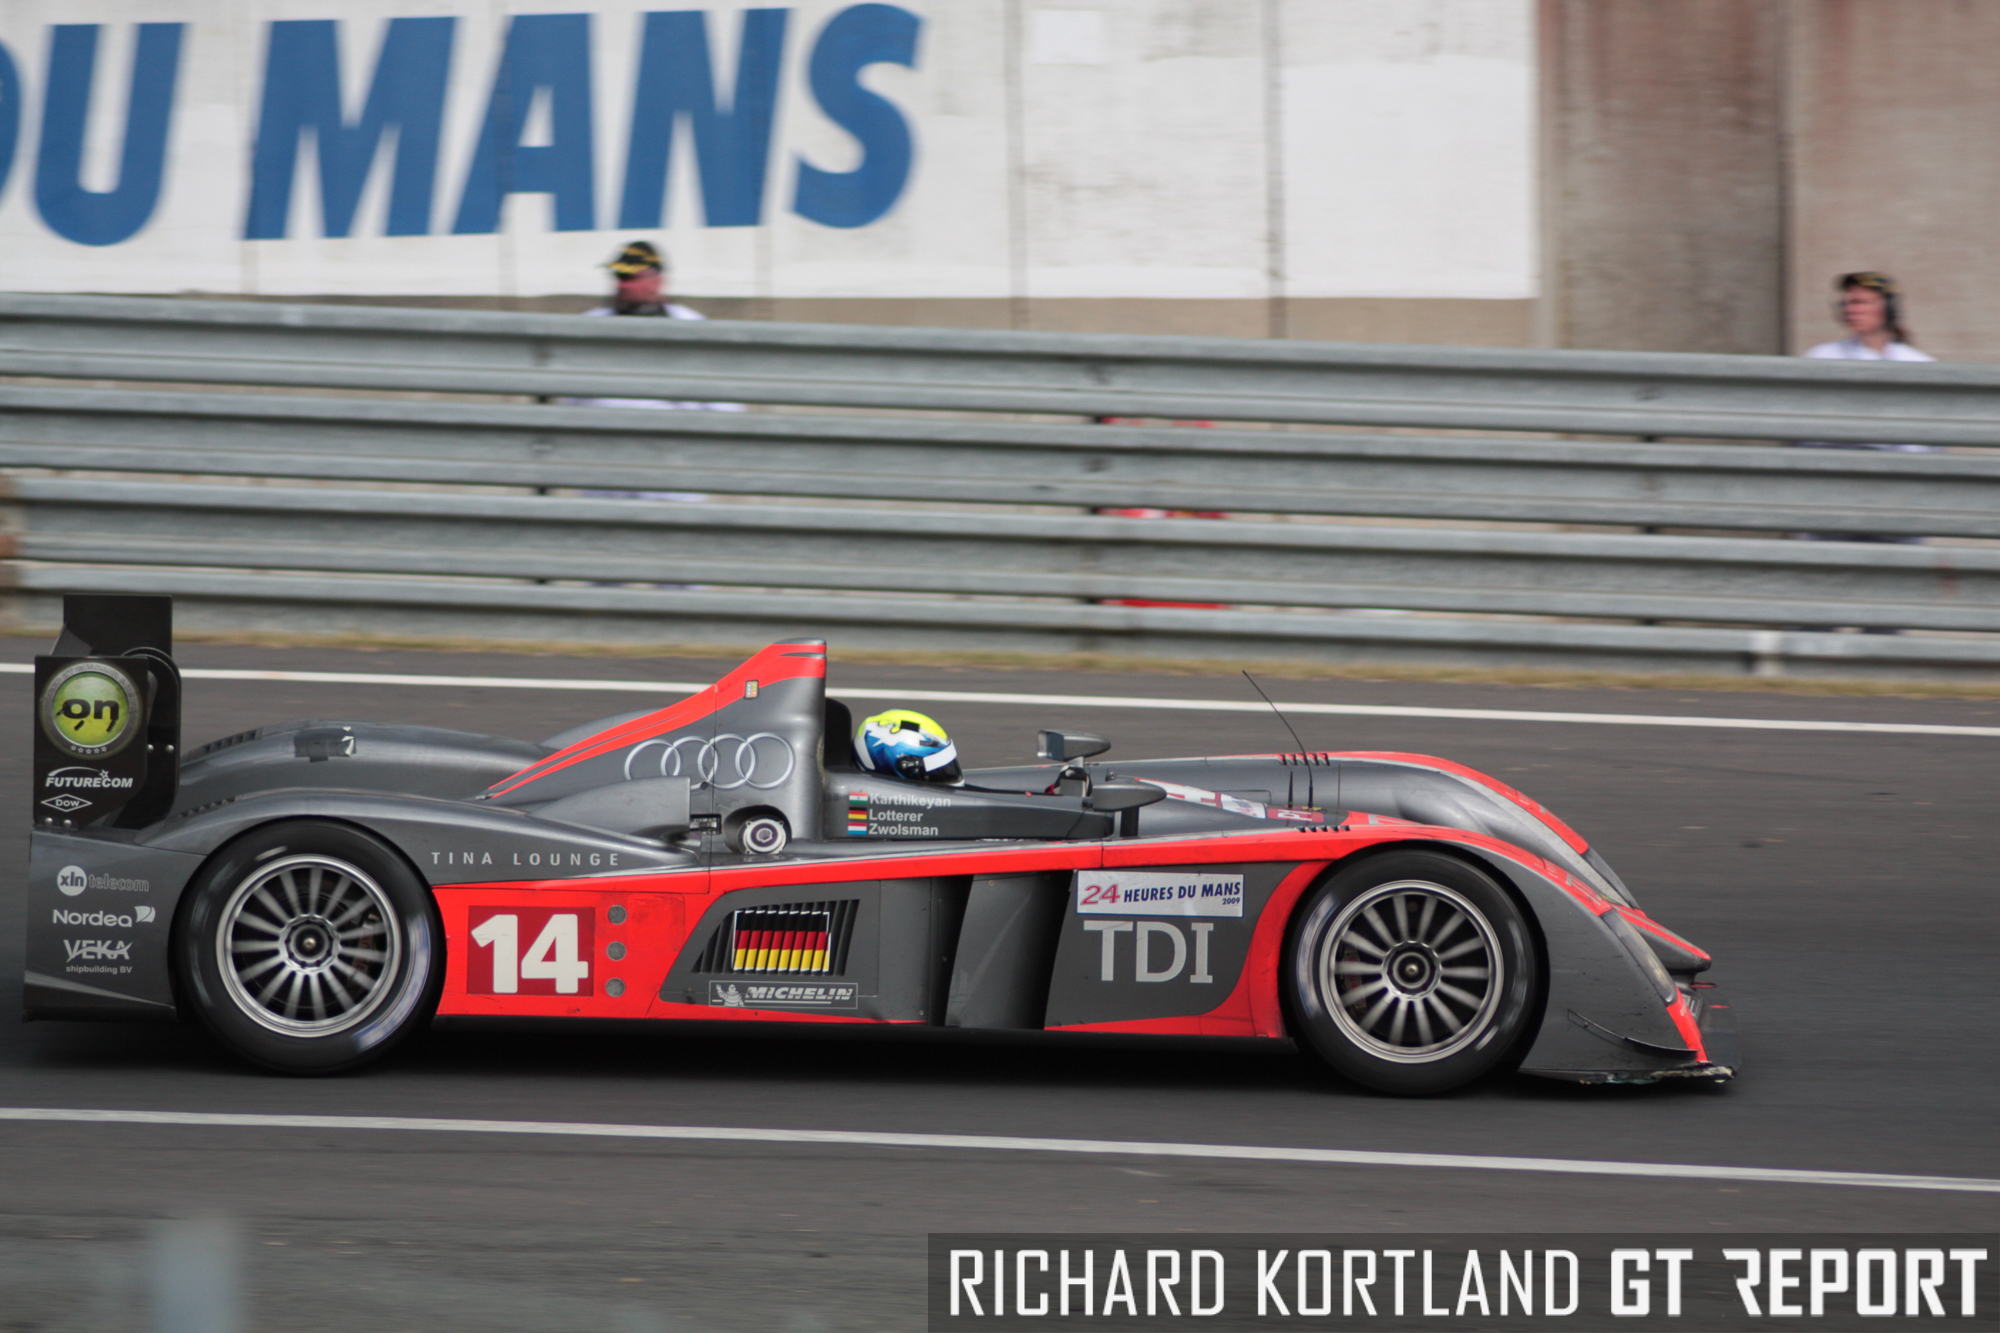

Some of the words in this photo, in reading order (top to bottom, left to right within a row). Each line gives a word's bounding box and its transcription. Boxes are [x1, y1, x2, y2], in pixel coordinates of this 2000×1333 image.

[0, 22, 188, 247] U
[242, 2, 927, 240] MANS
[45, 777, 134, 788] FUTURECOM
[869, 793, 951, 809] Karthikeyan
[869, 808, 923, 822] Lotterer
[869, 823, 939, 836] Zwolsman
[431, 852, 493, 865] TINA
[513, 852, 619, 866] LOUNGE
[88, 873, 149, 892] telecom
[1080, 884, 1121, 905] 24
[1124, 886, 1174, 903] HEURES
[1178, 885, 1197, 899] DU
[1201, 882, 1241, 898] MANS
[1222, 897, 1241, 905] 2009
[53, 909, 133, 928] Nordea
[63, 939, 133, 962] VEKA
[471, 913, 589, 993] 14
[1083, 920, 1214, 984] TDI
[66, 965, 118, 975] shipbuilding
[119, 966, 133, 974] BV
[745, 986, 853, 1000] MICHELIN
